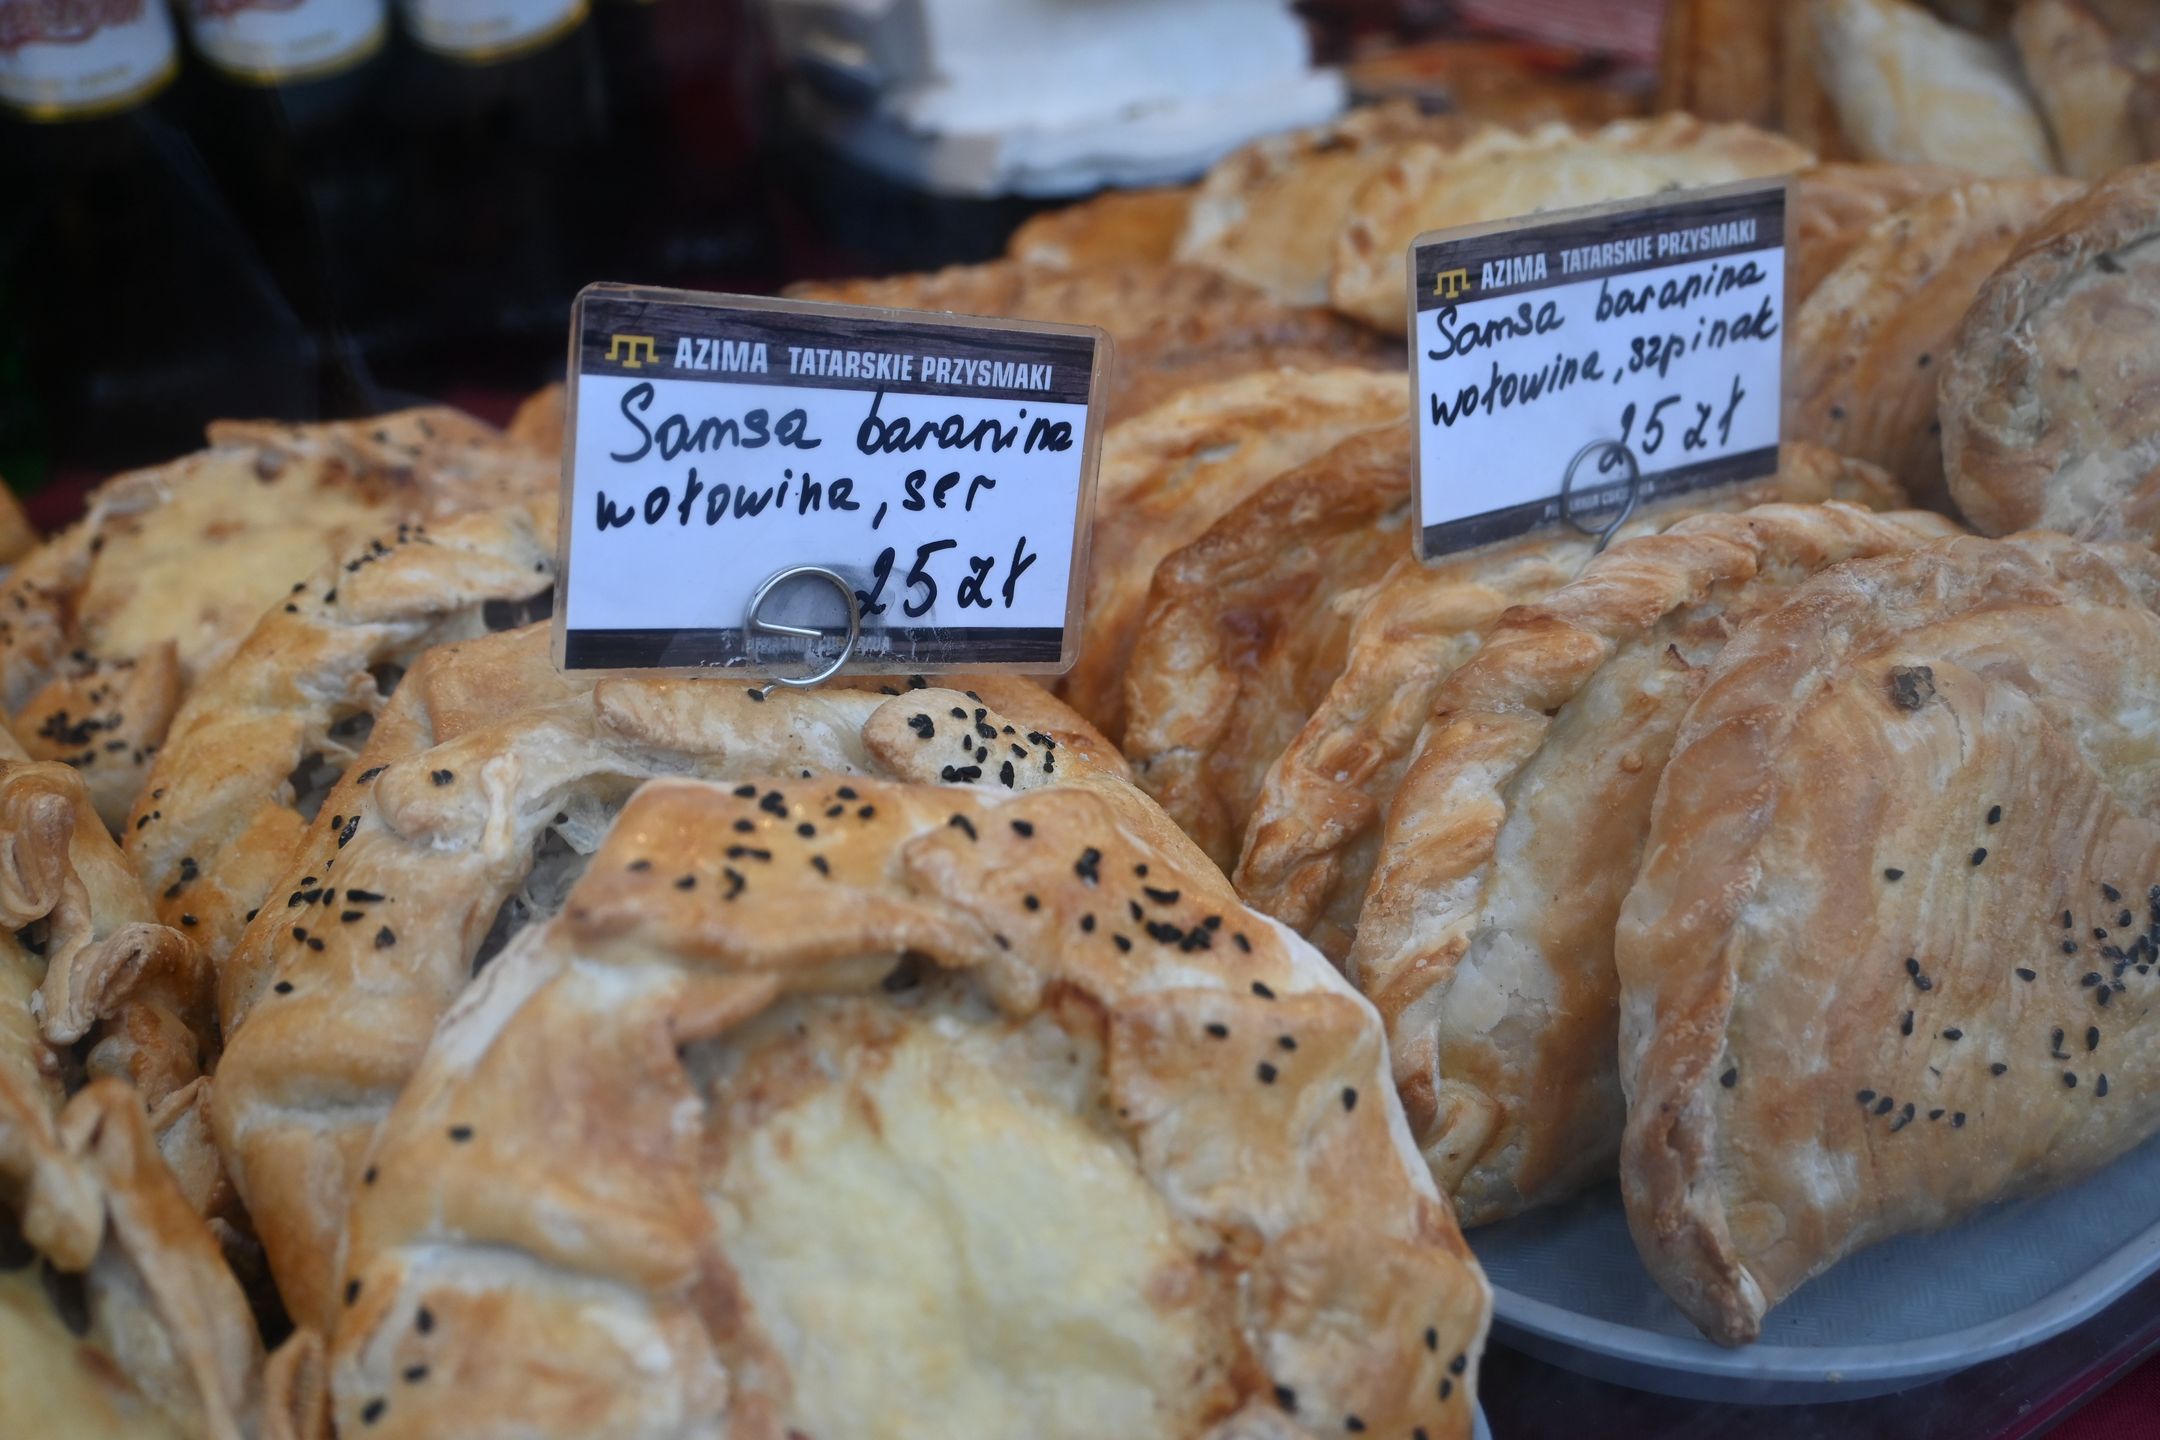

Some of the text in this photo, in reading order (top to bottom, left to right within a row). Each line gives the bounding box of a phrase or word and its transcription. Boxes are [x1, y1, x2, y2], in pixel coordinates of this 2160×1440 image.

[1480, 219, 1757, 291] AZIMA TATARSKIE PRZYSMAKI
[1427, 263, 1767, 362] Samsa baranina
[673, 336, 1053, 391] AZIMA TATARSKIE PRZYSMAKI
[610, 382, 1074, 463] Samsa baranina
[855, 535, 1038, 620] 25 zł
